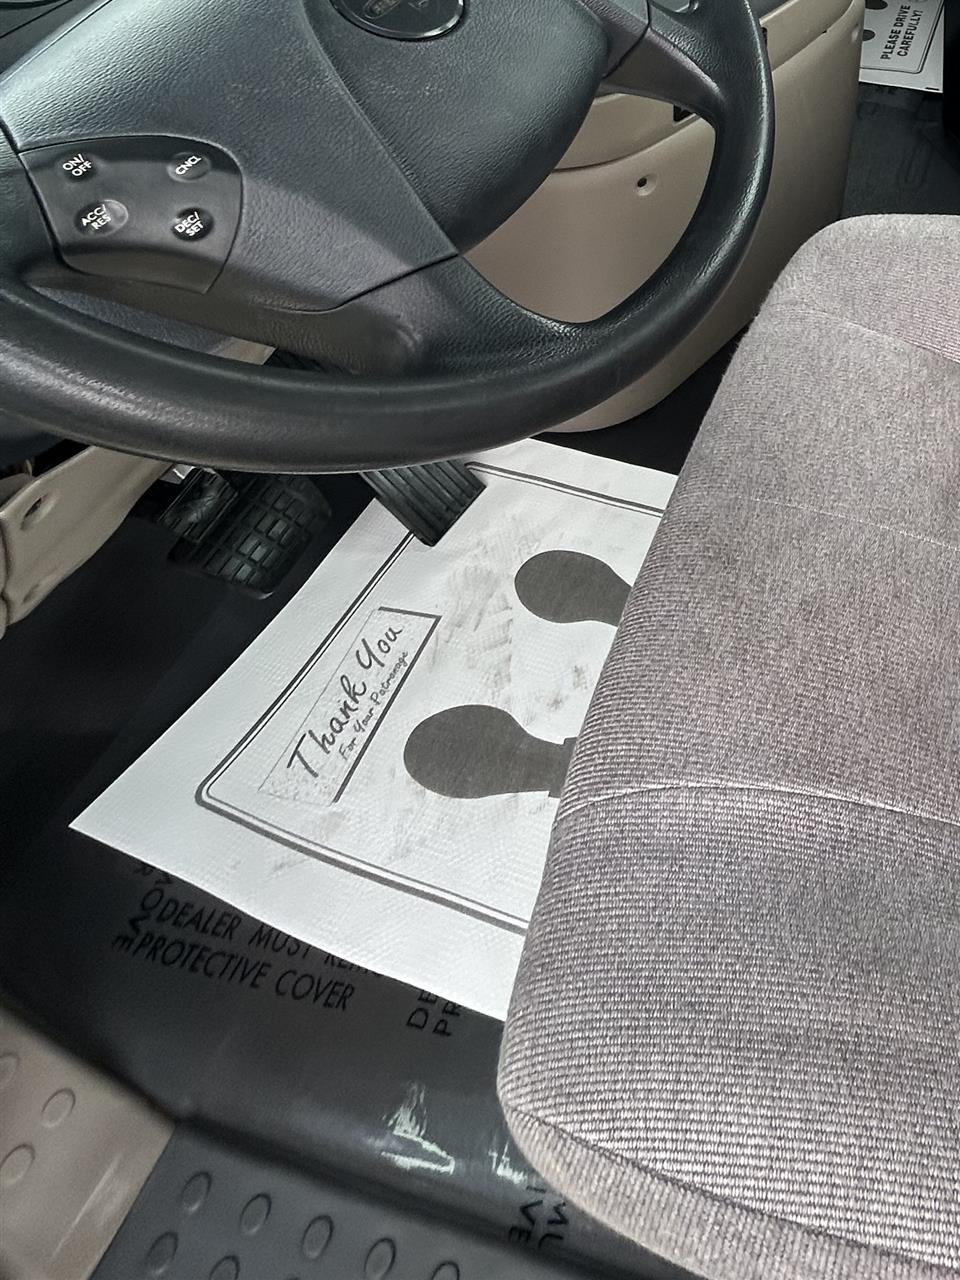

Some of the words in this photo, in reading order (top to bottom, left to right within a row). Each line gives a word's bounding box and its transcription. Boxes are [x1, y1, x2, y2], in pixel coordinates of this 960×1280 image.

[880, 28, 901, 60] PLEASE
[893, 5, 911, 28] DRIVE
[897, 9, 923, 57] CAREFULLY!
[63, 153, 85, 171] ON/
[72, 160, 92, 176] OFF
[175, 155, 202, 175] CNCL
[81, 204, 107, 227] ACC/
[92, 214, 112, 230] RES
[174, 212, 200, 233] DEC/
[185, 222, 204, 237] SET
[286, 674, 367, 778] Thank
[355, 626, 403, 670] You
[338, 737, 357, 761] For
[353, 707, 375, 733] Your
[370, 651, 409, 706] Patronage
[156, 897, 243, 941] DEALER
[132, 931, 272, 990] PROTECTIVE
[275, 969, 356, 1012] COVER
